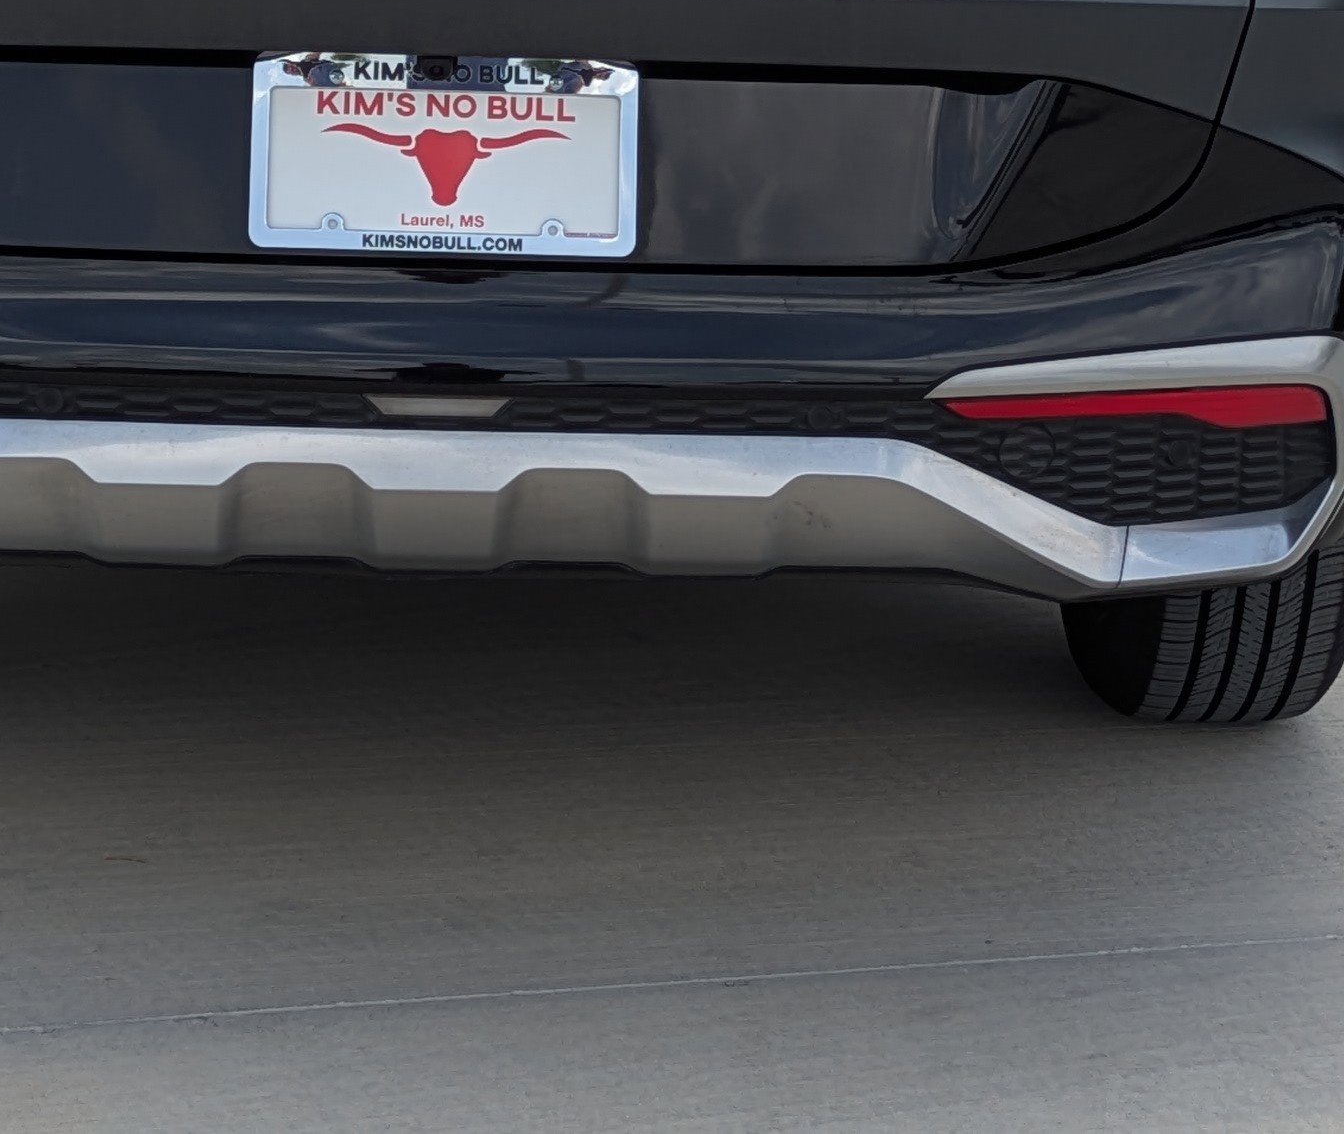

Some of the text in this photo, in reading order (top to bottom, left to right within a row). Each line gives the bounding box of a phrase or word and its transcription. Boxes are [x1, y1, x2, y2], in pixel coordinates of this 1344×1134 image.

[479, 64, 545, 85] BULL
[316, 91, 576, 123] KIM'S NO BULL
[400, 212, 485, 229] Laurel, MS
[362, 233, 523, 252] KIMSNOBULL.COM
